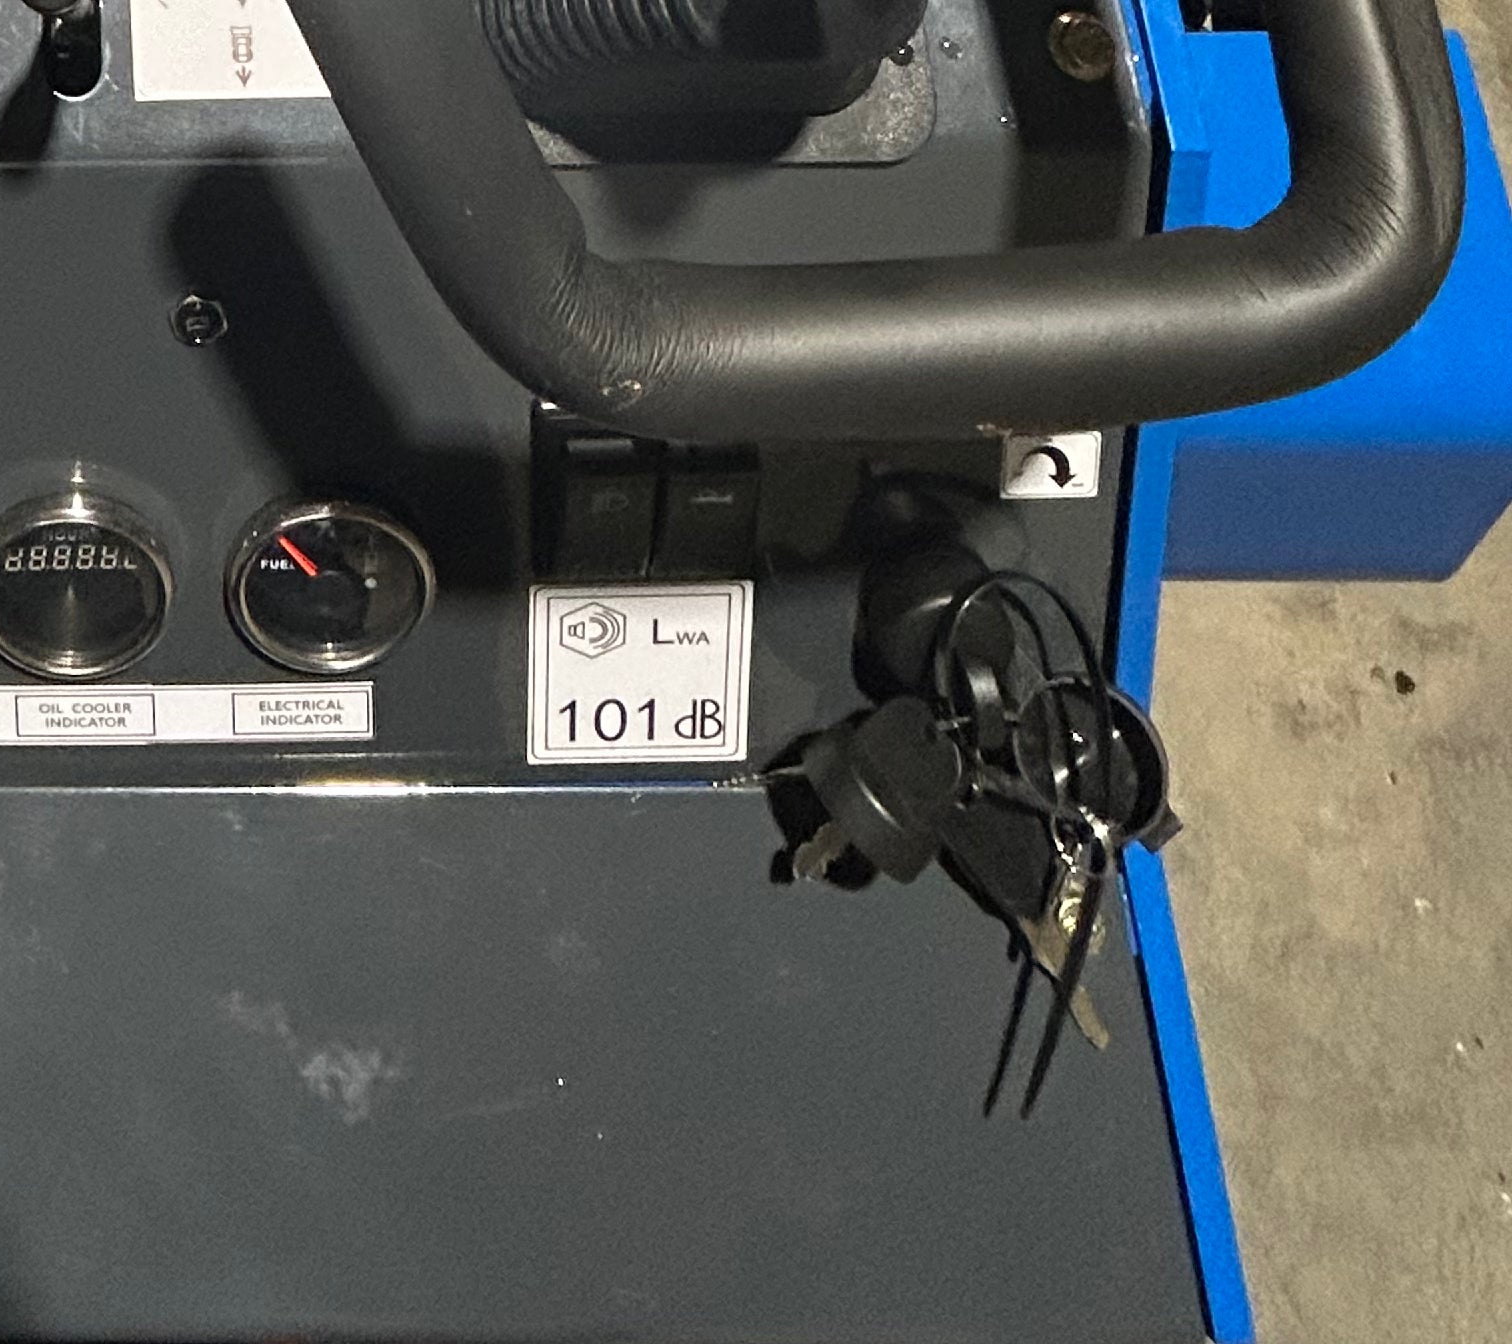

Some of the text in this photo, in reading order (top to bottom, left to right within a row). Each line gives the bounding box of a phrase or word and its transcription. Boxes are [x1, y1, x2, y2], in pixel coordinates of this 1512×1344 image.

[38, 702, 132, 714] OIL COOLER
[258, 699, 344, 712] ELECTRICAL
[45, 716, 128, 728] INDICATOR
[260, 713, 343, 726] INDICATOR
[559, 698, 723, 742] 101 dB
